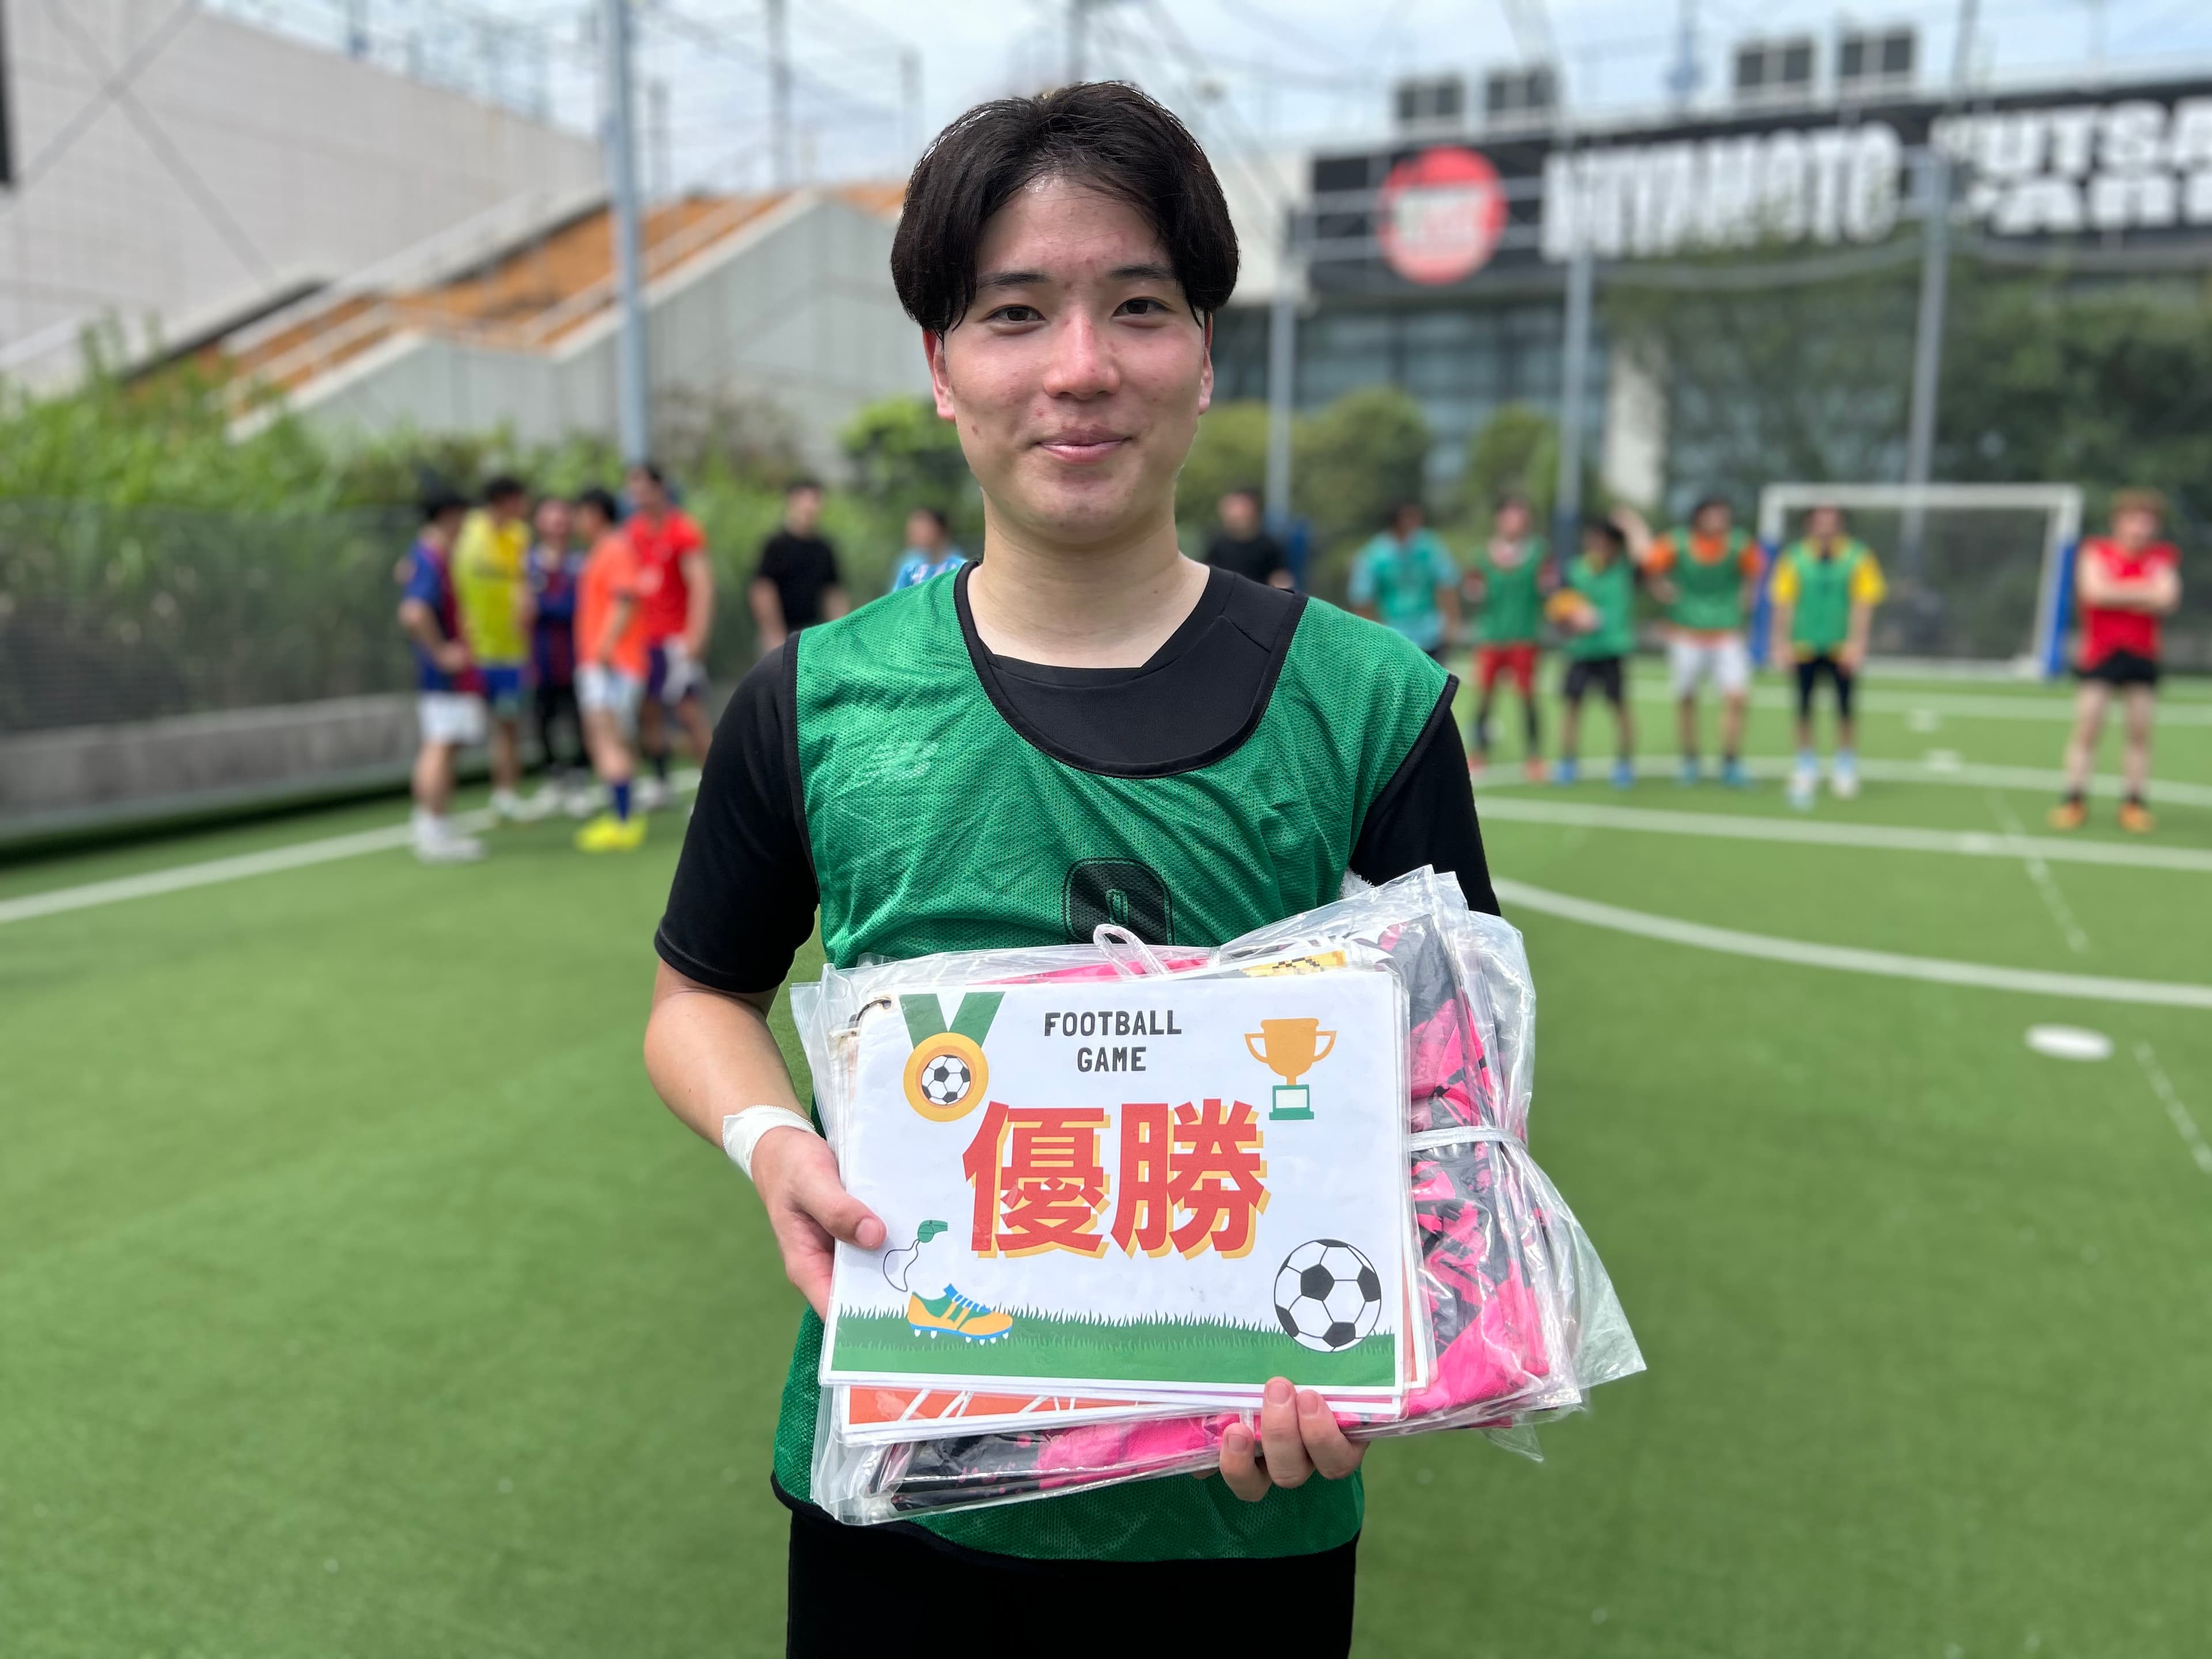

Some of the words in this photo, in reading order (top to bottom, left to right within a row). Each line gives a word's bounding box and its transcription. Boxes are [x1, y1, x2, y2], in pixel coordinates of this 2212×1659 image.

[1044, 1009, 1182, 1036] FOOTBALL
[1077, 1046, 1146, 1072] GAME
[963, 1099, 1271, 1259] 優勝
